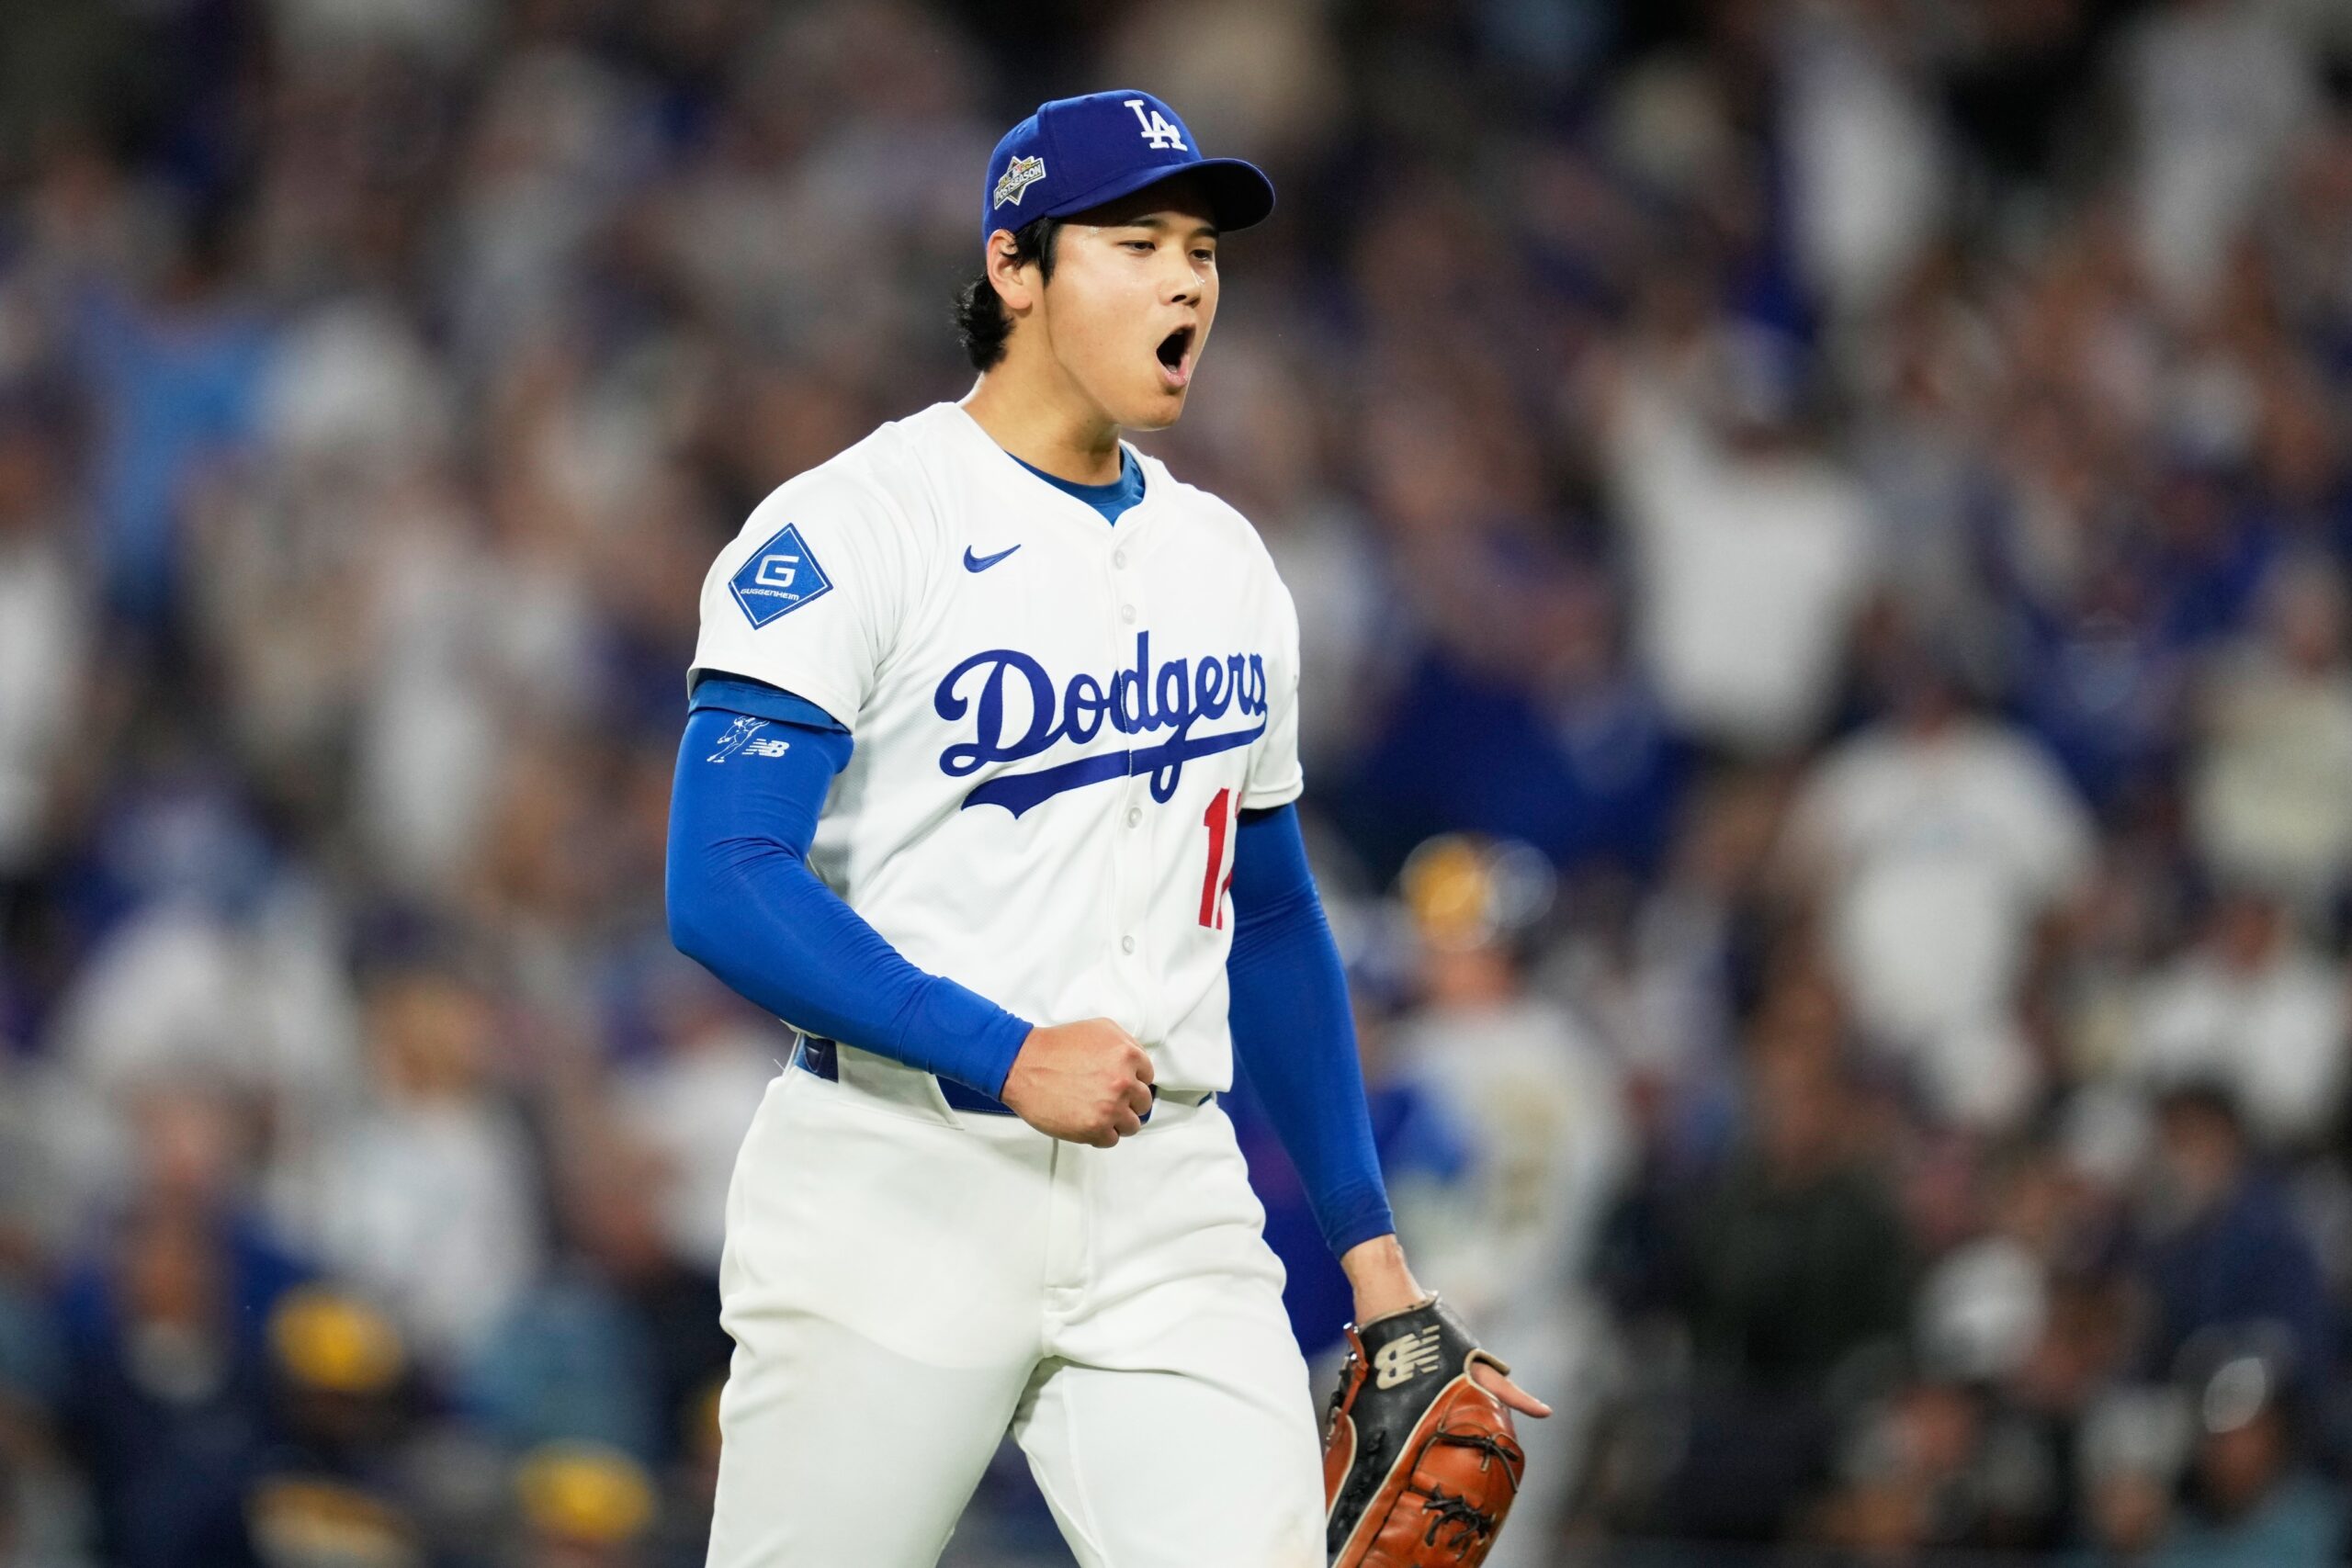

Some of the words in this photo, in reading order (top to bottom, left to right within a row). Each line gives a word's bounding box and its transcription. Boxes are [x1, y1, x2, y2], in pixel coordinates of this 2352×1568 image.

[1124, 99, 1188, 152] LA
[740, 588, 800, 602] GUGGENHEIM
[754, 554, 799, 588] G
[933, 629, 1268, 805] Dodgers
[1198, 787, 1242, 931] 1
